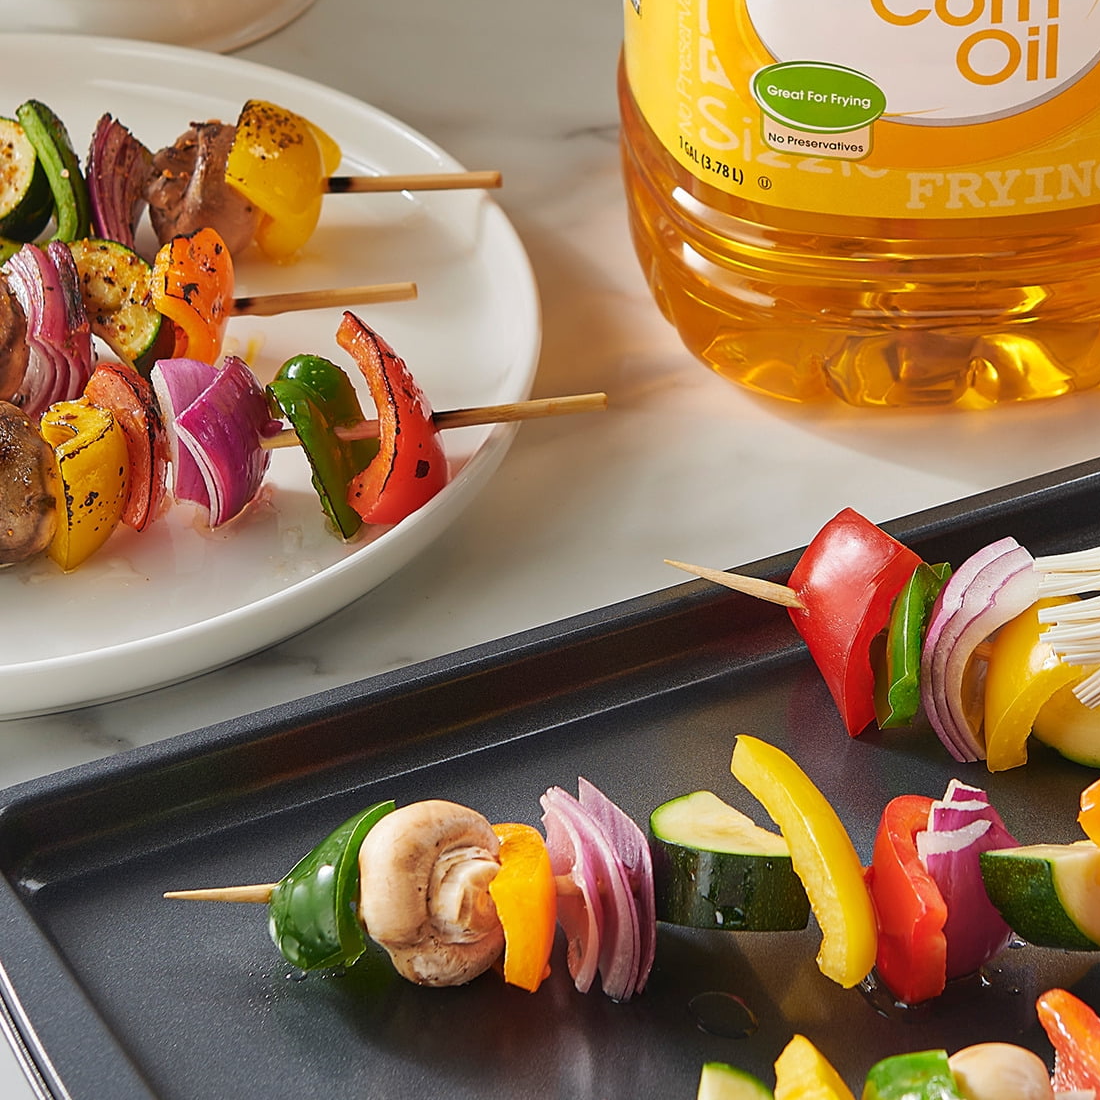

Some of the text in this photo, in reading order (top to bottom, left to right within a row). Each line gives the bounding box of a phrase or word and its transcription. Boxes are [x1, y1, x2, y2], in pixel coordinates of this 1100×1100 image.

[955, 23, 1059, 86] Oil
[766, 84, 872, 110] Great For Frying
[697, 94, 891, 179] Sizz
[768, 132, 865, 153] No Preservatives
[684, 141, 700, 164] GAL
[701, 152, 731, 180] (3.78
[731, 167, 745, 186] L)
